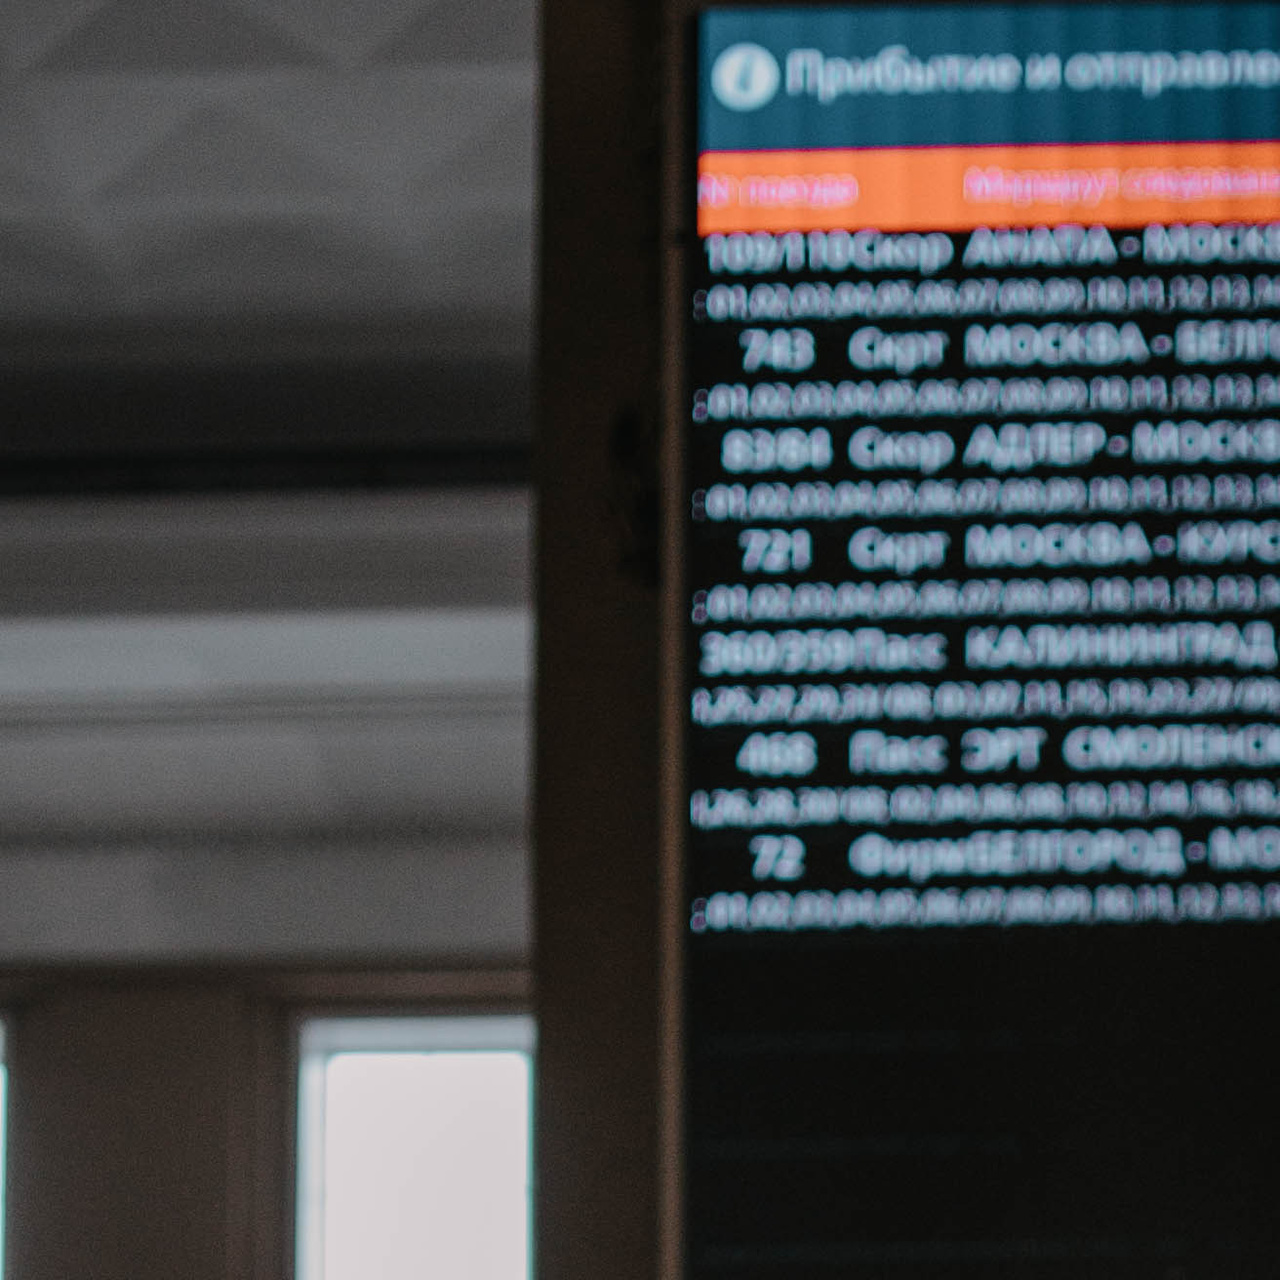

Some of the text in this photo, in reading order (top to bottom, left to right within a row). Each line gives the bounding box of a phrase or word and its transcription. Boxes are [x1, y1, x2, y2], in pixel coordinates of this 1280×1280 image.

[786, 45, 1022, 103] Прибытие
[1024, 53, 1062, 92] и
[963, 322, 1150, 367] МОСКВА
[848, 426, 955, 474] Скор
[963, 422, 1106, 472] АДЛЕР
[965, 522, 1152, 567] МОСКВА
[965, 621, 1278, 669] КАЛИНИНГРАД
